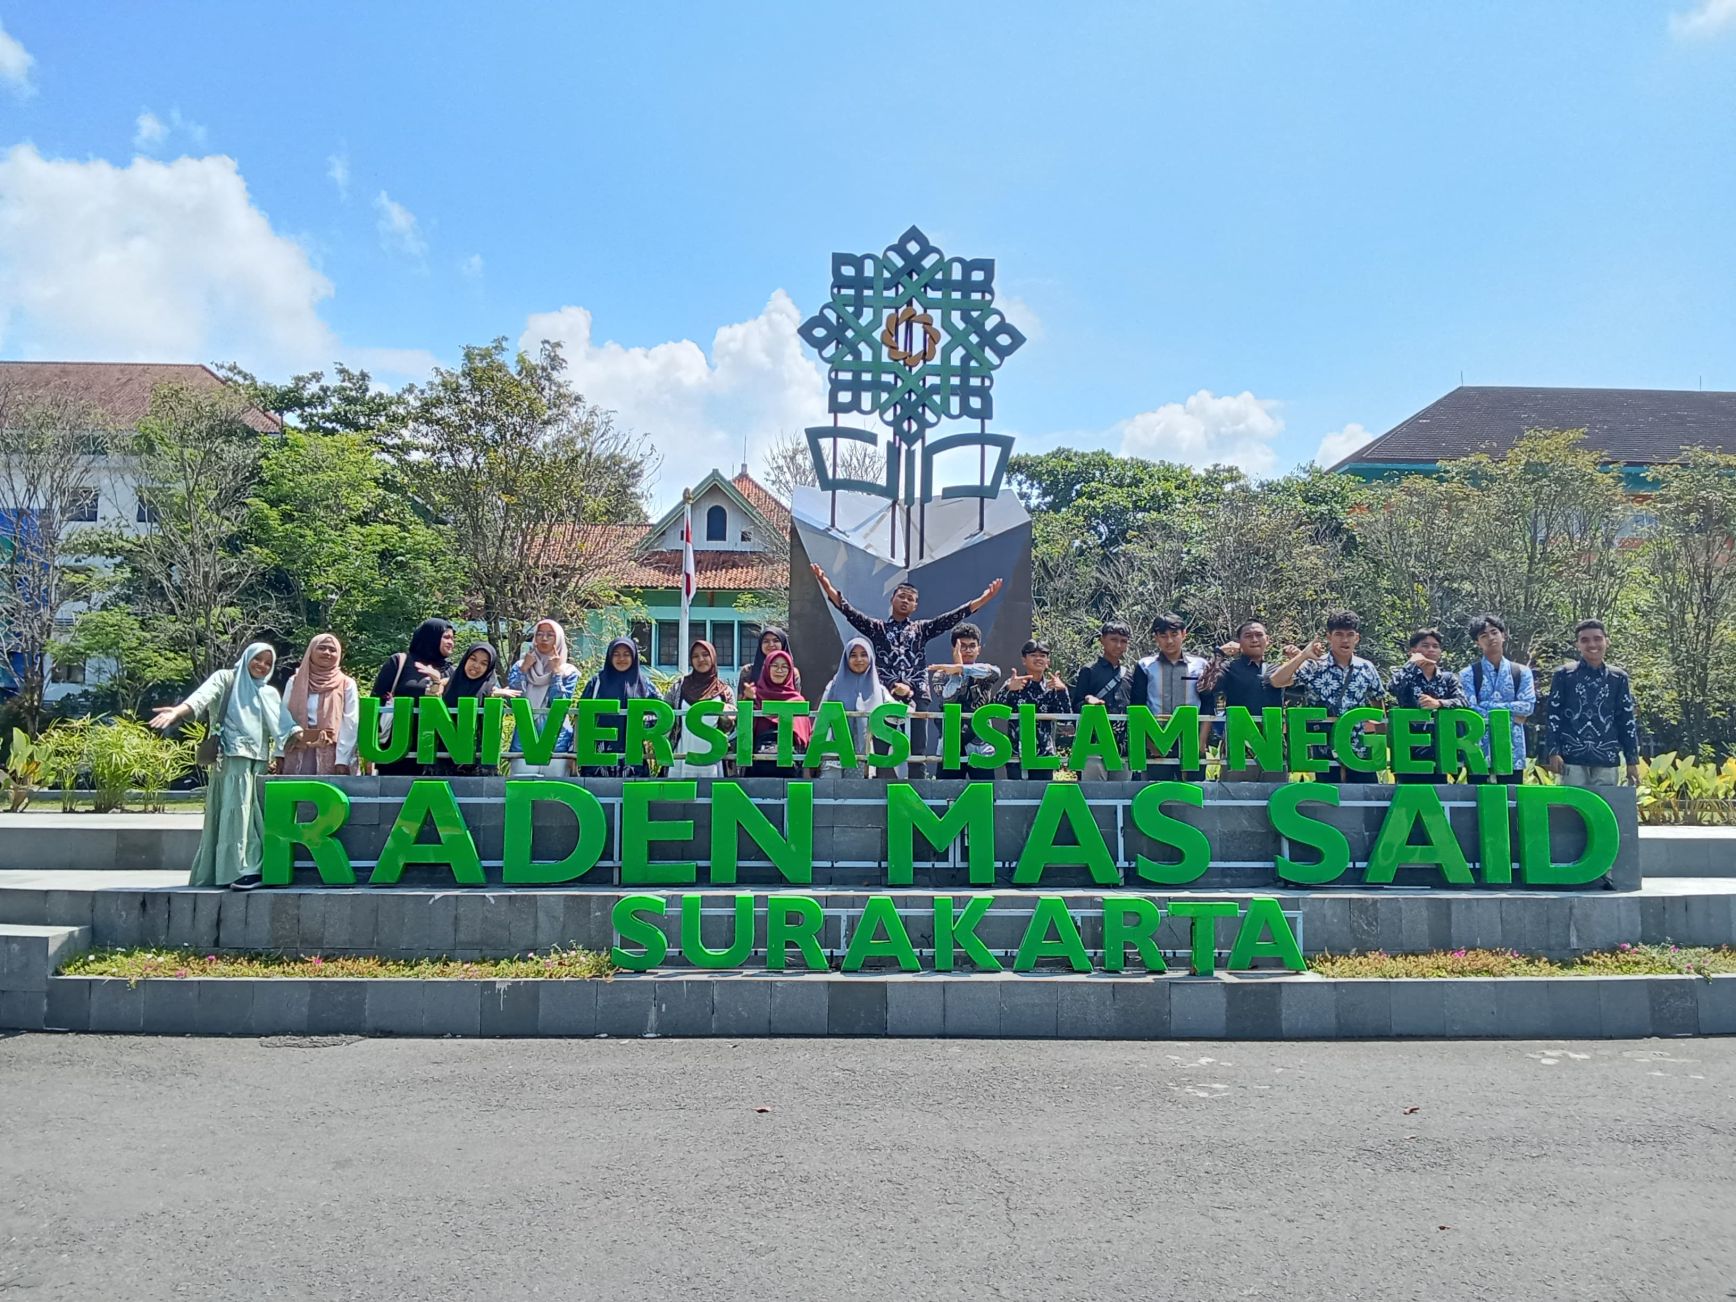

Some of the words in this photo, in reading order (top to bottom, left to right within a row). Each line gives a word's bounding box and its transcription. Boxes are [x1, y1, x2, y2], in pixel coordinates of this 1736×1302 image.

[357, 696, 911, 769] UNIVERSITAS
[942, 702, 1201, 773] ISLAM
[1226, 705, 1514, 776] NEGERI
[261, 778, 814, 885] RADEN
[886, 780, 1212, 885] MAS
[1267, 780, 1621, 885] SAID
[610, 895, 1308, 976] SURAKARTA
